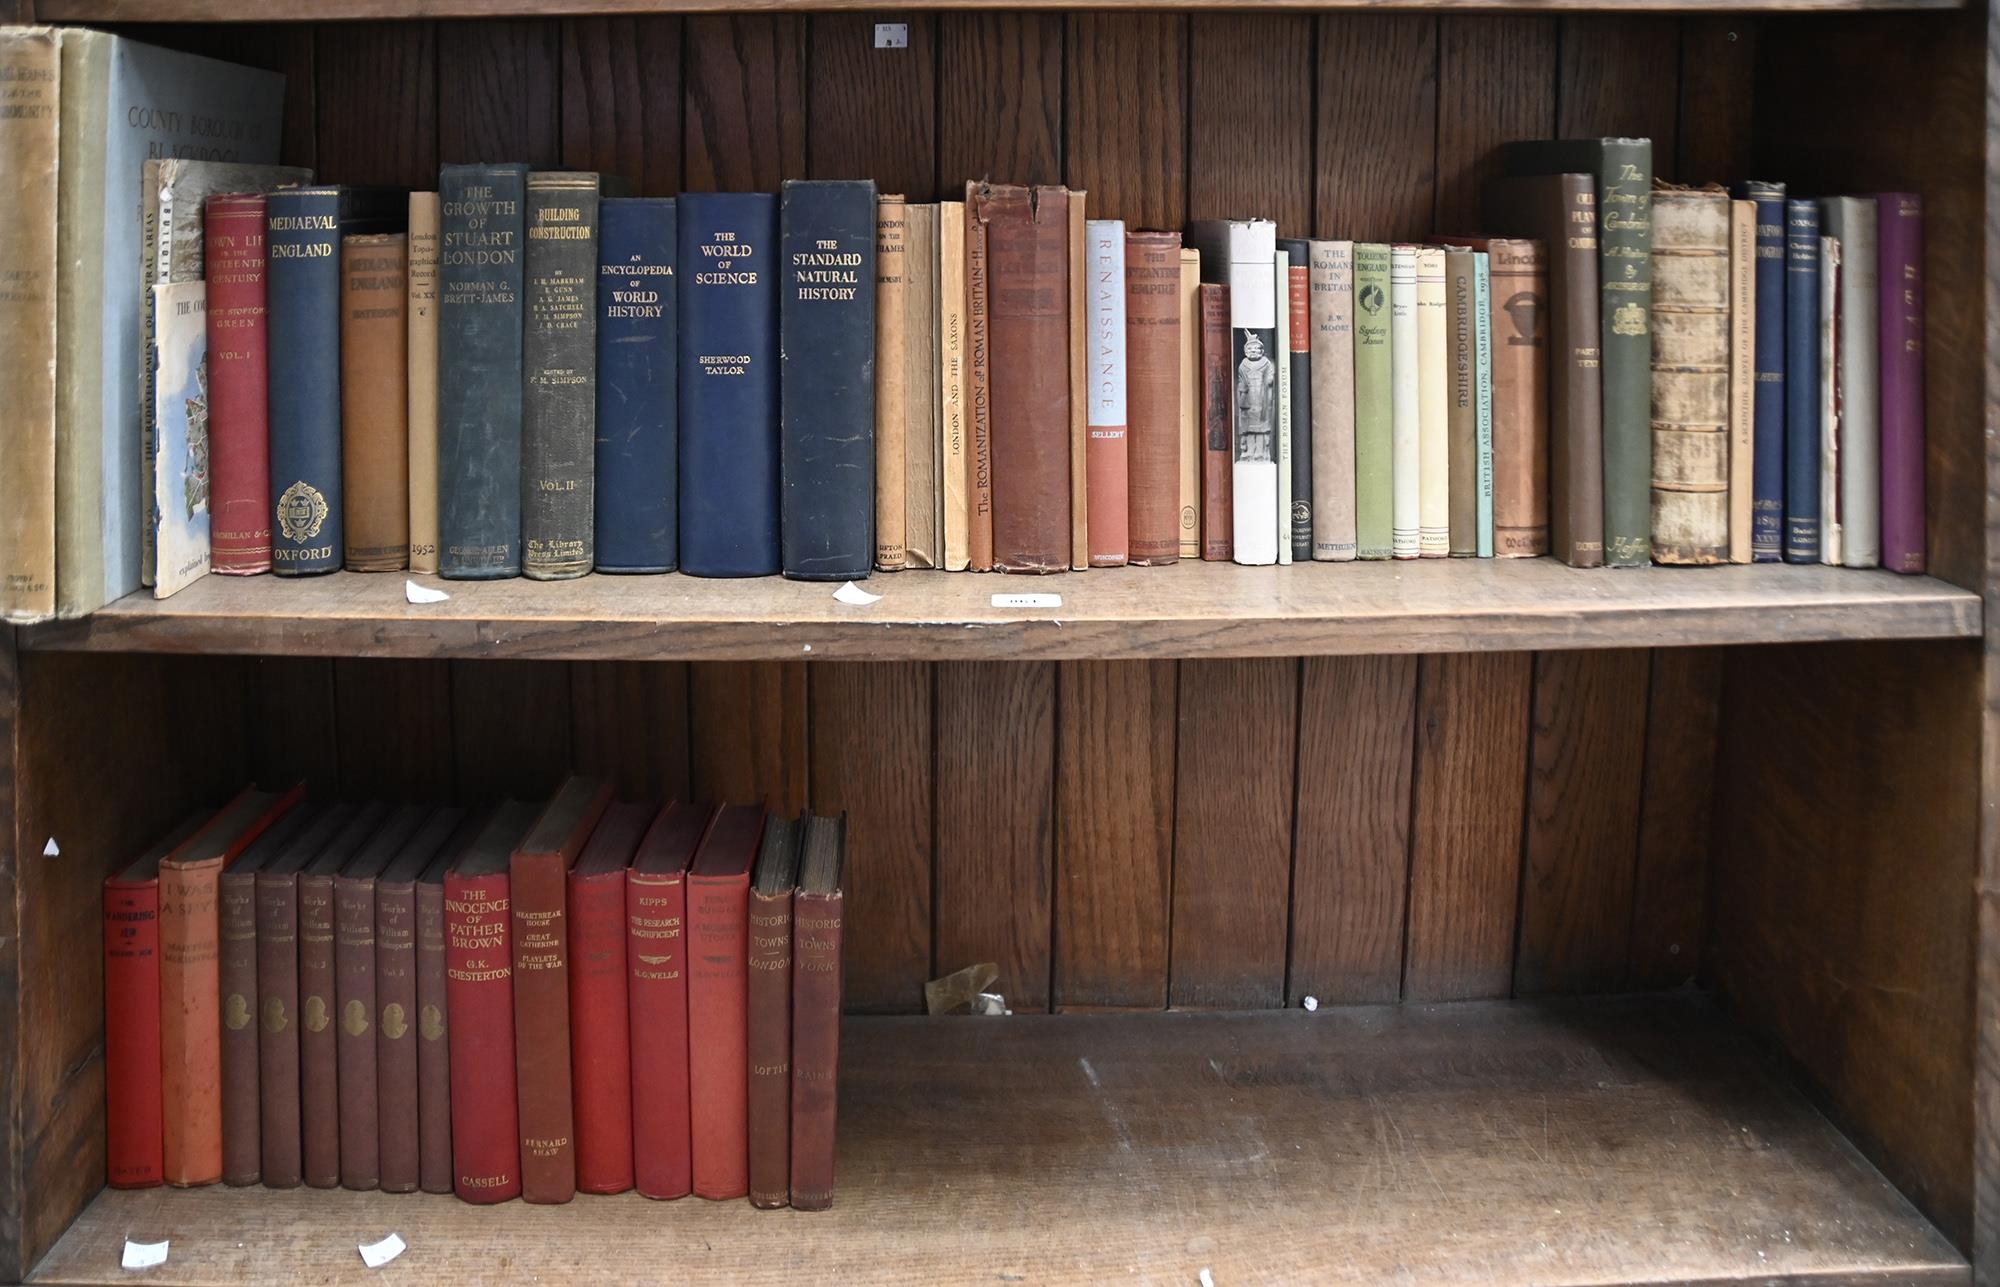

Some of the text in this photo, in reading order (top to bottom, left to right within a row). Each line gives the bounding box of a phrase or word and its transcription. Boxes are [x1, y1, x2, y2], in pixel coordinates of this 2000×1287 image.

[1619, 164, 1644, 181] The
[466, 185, 493, 198] THE
[443, 201, 516, 216] GROWTH
[538, 207, 580, 221] BUILDING
[269, 216, 337, 231] MEDIAEVAL
[468, 218, 487, 230] OF
[444, 231, 514, 246] STUART
[529, 226, 591, 240] CONSTRUCTION
[714, 232, 736, 241] THE
[271, 243, 332, 258] ENGLAND
[701, 244, 752, 257] WORLD
[816, 240, 838, 250] THE
[443, 249, 515, 265] LONDON
[630, 254, 641, 262] AN
[792, 253, 862, 266] STANDARD
[1324, 249, 1345, 258] THE
[601, 265, 673, 276] ENCYCLOPEDIA
[717, 260, 732, 269] OF
[1357, 263, 1388, 272] ENGLAND
[695, 272, 758, 285] SCIENCE
[796, 270, 858, 283] NATURAL
[1329, 272, 1341, 280] IN
[449, 281, 510, 291] NORMAN G.
[629, 280, 641, 288] OF
[1130, 283, 1176, 295] EMPIRE
[1314, 283, 1353, 292] BRITAIN
[444, 293, 514, 304] BRETT-JAMES
[612, 291, 658, 303] WORLD
[798, 287, 857, 300] HISTORY
[176, 302, 192, 316] THE
[608, 305, 663, 318] HISTORY
[216, 319, 255, 328] GREEN
[1099, 239, 1114, 409] RENAISSANCE
[1359, 324, 1387, 336] Sydney
[144, 213, 155, 462] THE REDEVELOPMENT OF CENTRAL AREAS
[973, 317, 985, 369] ROMAN
[1457, 275, 1469, 409] CAMBRIDGESHIRE
[219, 351, 243, 360] VOL.
[699, 355, 751, 364] SHERWOOD
[705, 366, 745, 375] TAYLOR
[974, 370, 985, 381] of
[950, 313, 960, 456] LONDON AND THE SAXONS
[974, 385, 989, 490] ROMANIZATION
[1482, 450, 1492, 498] BRITISH
[977, 492, 989, 517] The
[274, 545, 333, 561] OXFORD
[412, 544, 435, 556] 1952
[176, 885, 213, 896] WAS
[462, 890, 486, 900] THE
[446, 899, 510, 914] INNOCENCE
[639, 897, 668, 906] KIPPS
[162, 903, 173, 914] A
[381, 903, 406, 914] Works
[105, 910, 155, 921] WANDERING
[389, 917, 398, 925] of
[466, 915, 483, 924] OF
[516, 910, 562, 920] HEARTBREAK
[526, 919, 550, 927] HOUSE
[631, 916, 680, 928] THE RESEARCH
[796, 917, 841, 929] HISTORIC
[450, 923, 505, 936] FATHER
[631, 928, 680, 939] MAGNIFICENT
[452, 936, 503, 950] BROWN
[526, 933, 551, 941] GREAT
[753, 935, 789, 948] TOWNS
[519, 940, 559, 948] CATHERINE
[799, 936, 836, 951] TOWNS
[522, 954, 558, 962] PLAYLETS
[748, 956, 791, 970] LONDON
[546, 961, 562, 969] WAR
[799, 960, 835, 972] YORK
[448, 967, 512, 981] CHESTERTON
[525, 1137, 568, 1148] BERNARD
[533, 1148, 559, 1156] SHAW
[462, 1175, 509, 1188] CASSELL
